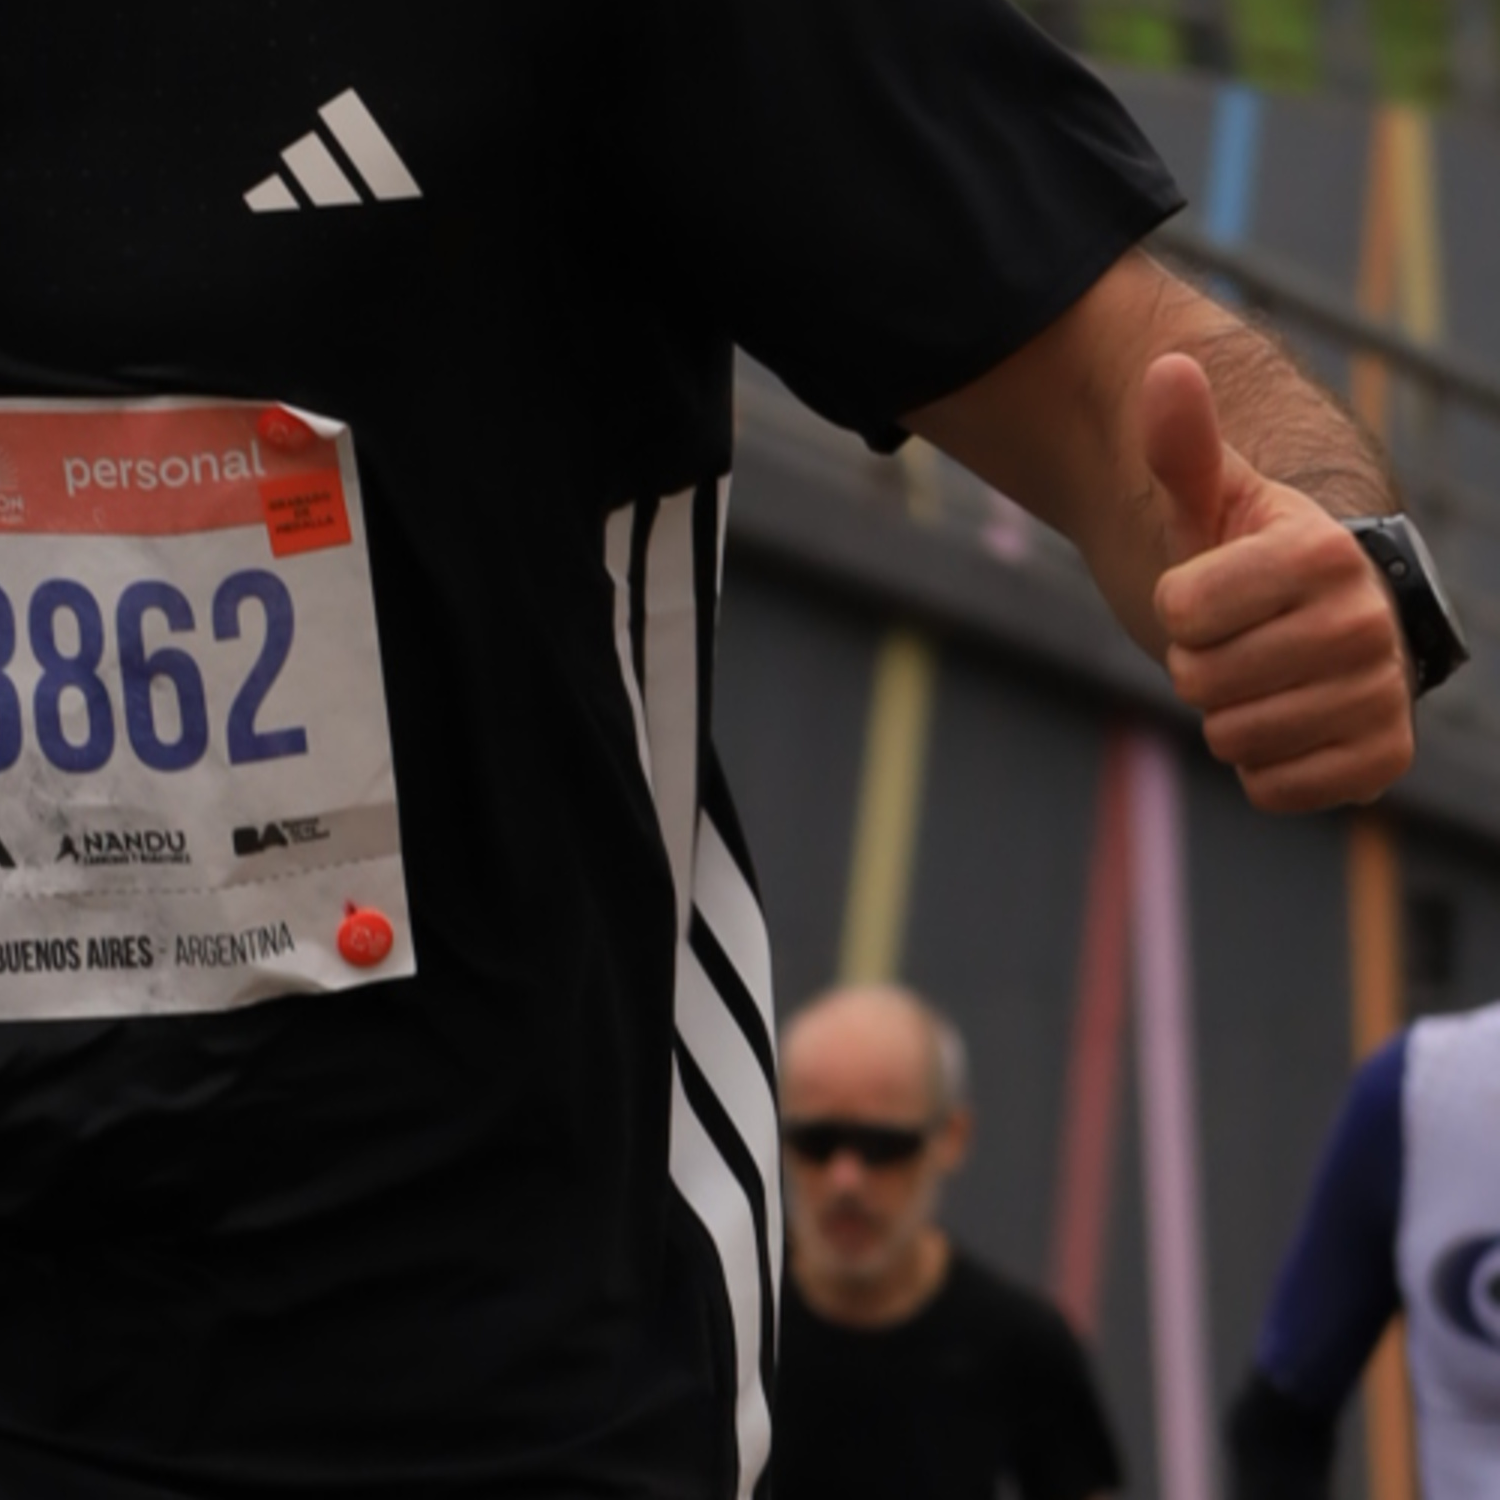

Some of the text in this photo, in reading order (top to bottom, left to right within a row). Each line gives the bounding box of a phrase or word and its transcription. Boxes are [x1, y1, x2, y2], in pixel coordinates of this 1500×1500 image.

[63, 438, 266, 497] personal
[86, 934, 154, 970] AIRES
[174, 920, 296, 967] ARGENTINA
